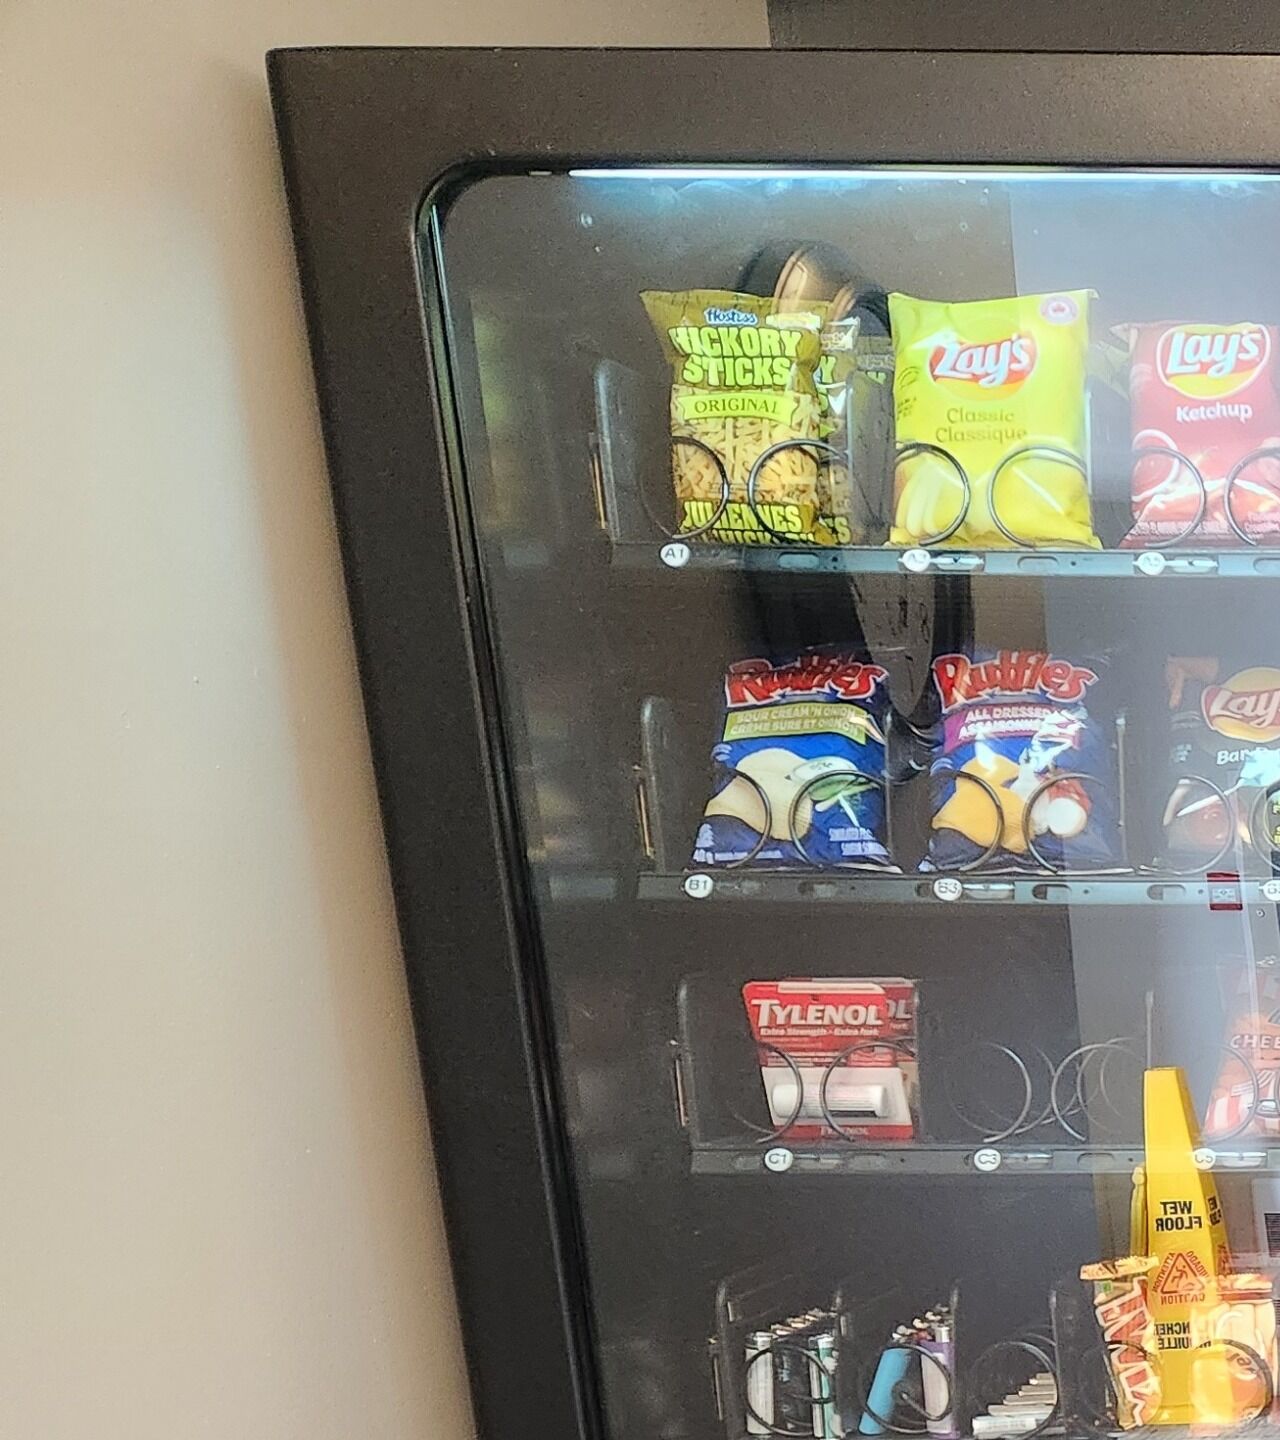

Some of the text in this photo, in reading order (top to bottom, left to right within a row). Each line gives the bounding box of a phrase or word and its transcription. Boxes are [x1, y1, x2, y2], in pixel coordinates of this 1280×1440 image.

[704, 307, 758, 325] Hostess
[669, 326, 802, 359] HICKORY
[1165, 327, 1264, 379] Lay's
[932, 334, 1036, 389] Lay's
[683, 357, 793, 388] STICKS
[694, 394, 782, 416] ORIGINAL
[946, 406, 1015, 424] Classic
[1175, 403, 1253, 424] Ketchup
[935, 425, 1028, 444] Classique
[664, 549, 686, 561] A1
[724, 656, 889, 708] Ruffles
[931, 650, 1099, 711] Ruffles
[966, 705, 1046, 721] ALL DRESSED
[800, 720, 815, 731] ET
[689, 879, 709, 892] B1
[750, 998, 884, 1027] TYLENOL
[768, 1152, 788, 1166] C1
